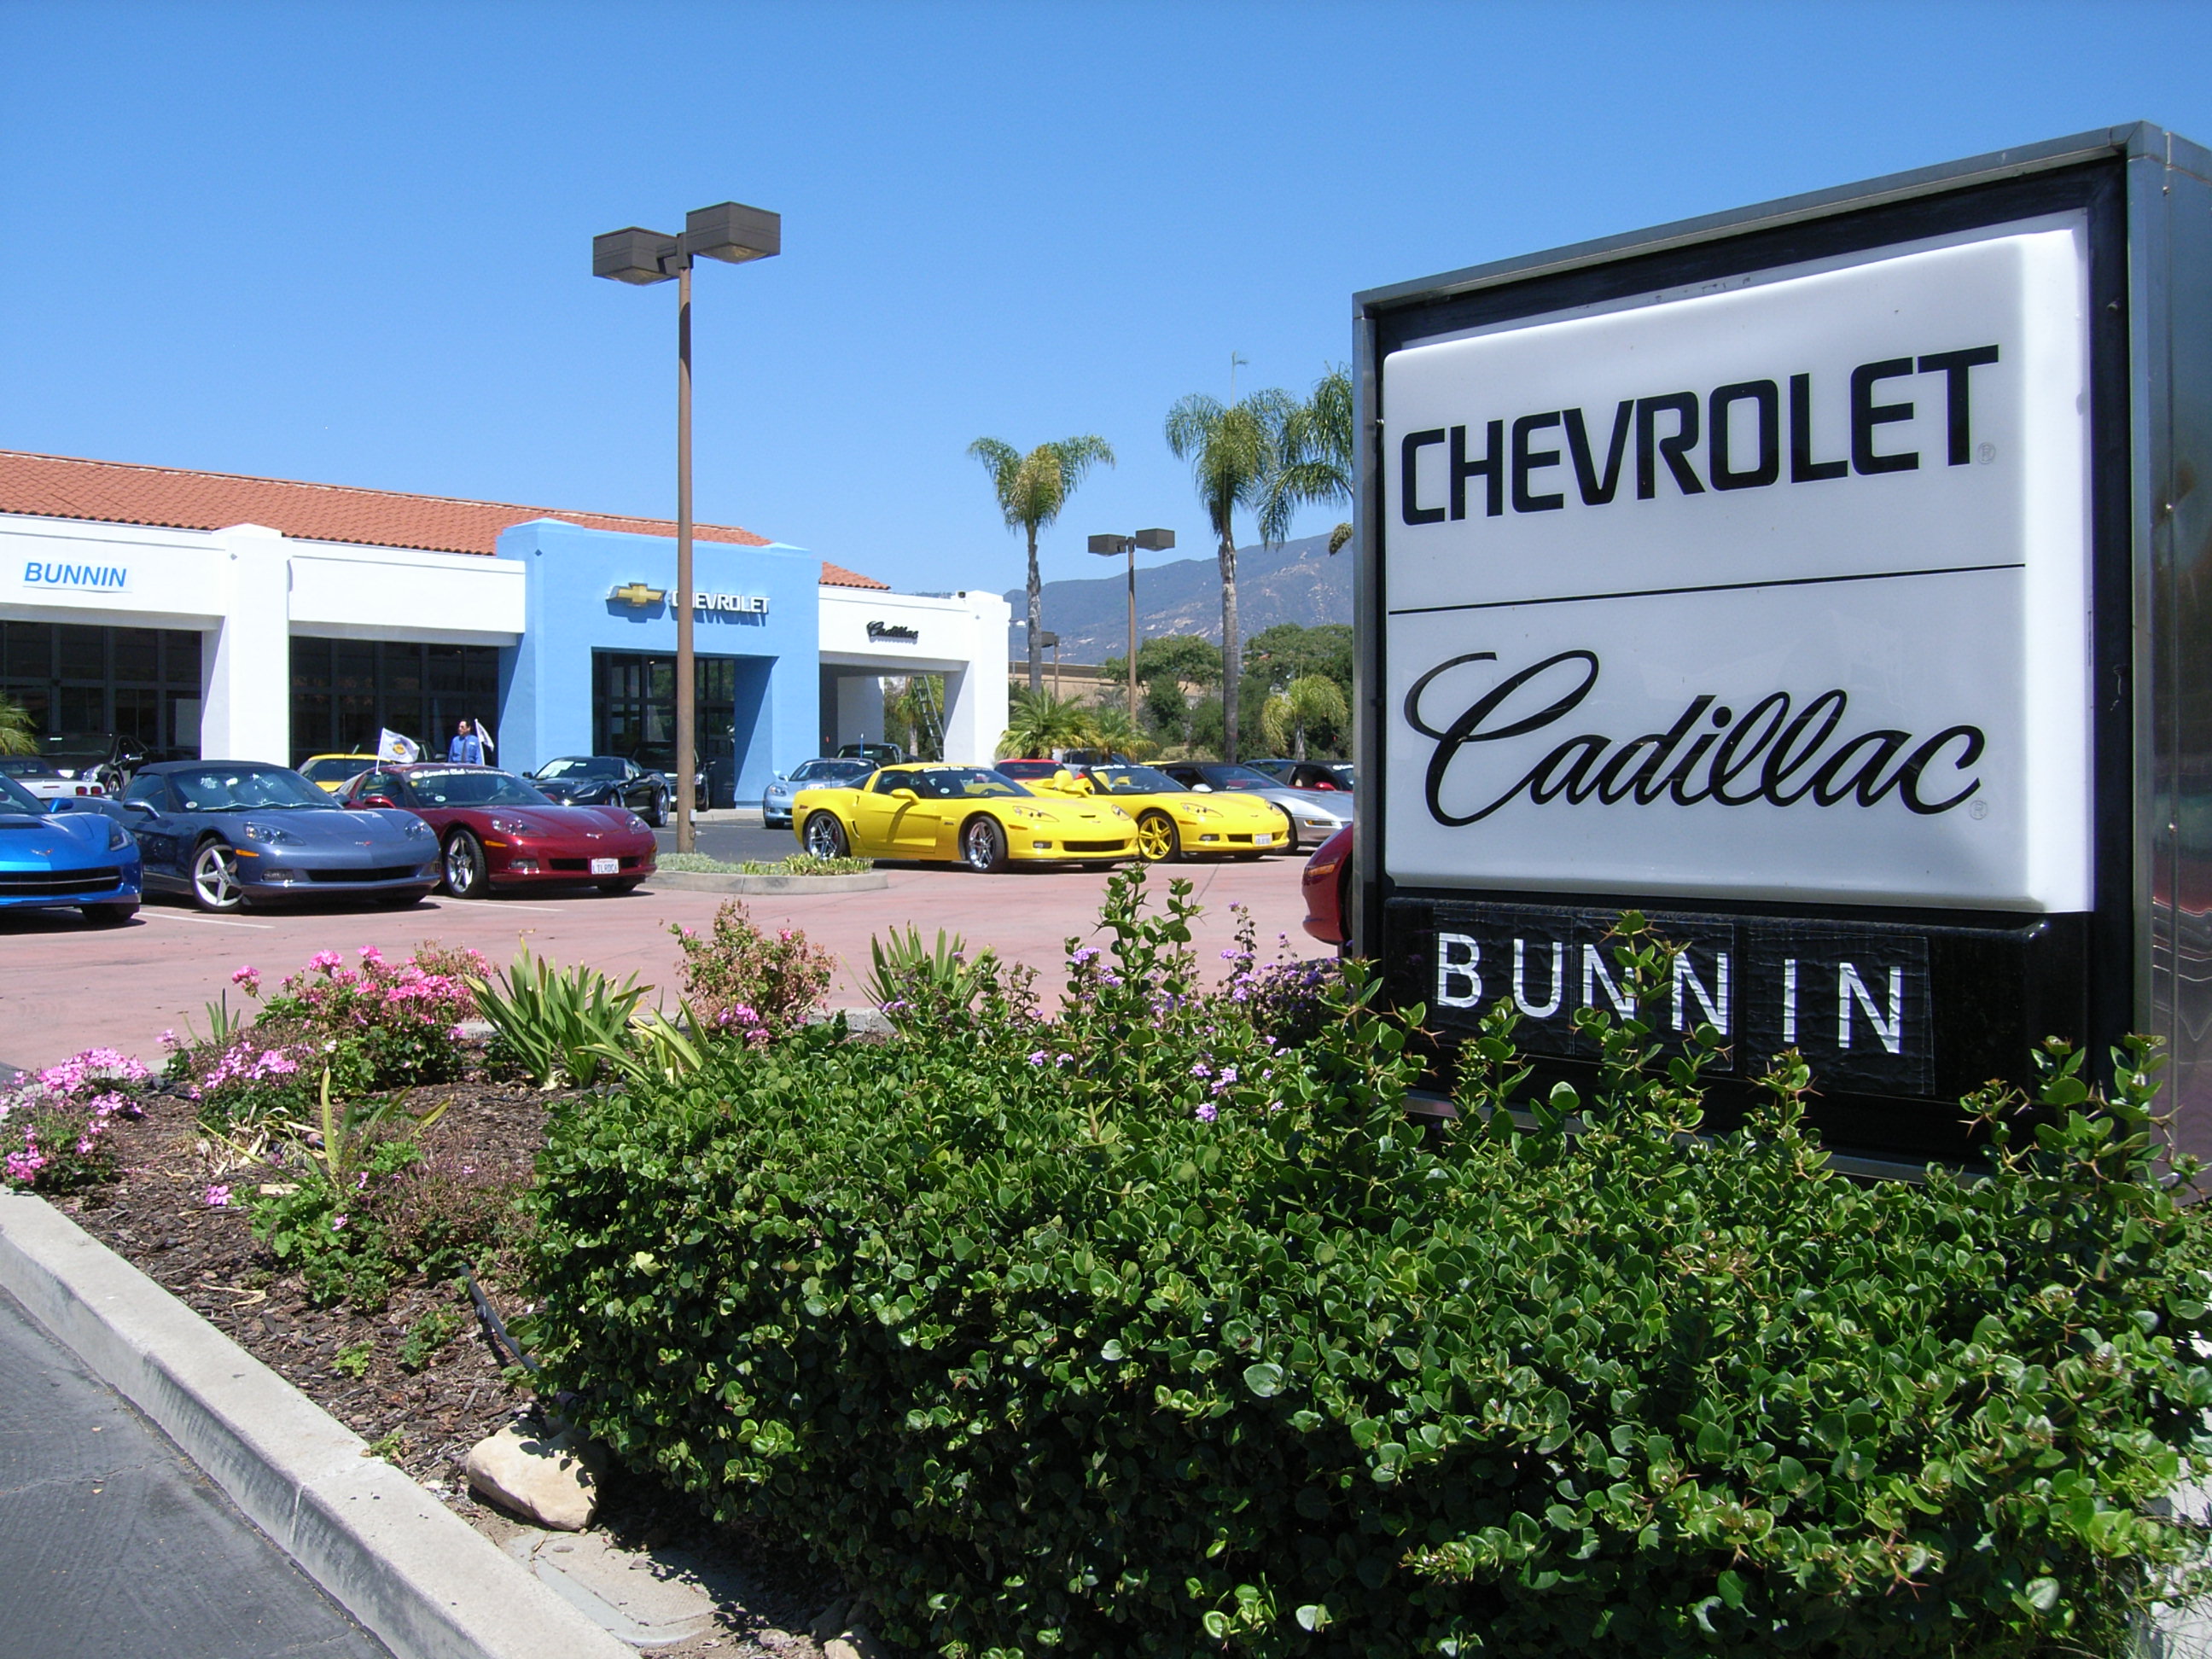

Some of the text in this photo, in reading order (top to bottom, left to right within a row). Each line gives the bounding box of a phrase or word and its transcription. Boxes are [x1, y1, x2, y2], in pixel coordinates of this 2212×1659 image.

[1401, 344, 2000, 527] CHEVROLET
[24, 562, 127, 588] BUNNIN
[866, 620, 919, 639] Cadillac
[1403, 649, 1985, 828] Cadillac
[1437, 932, 1902, 1055] BUNNIN
